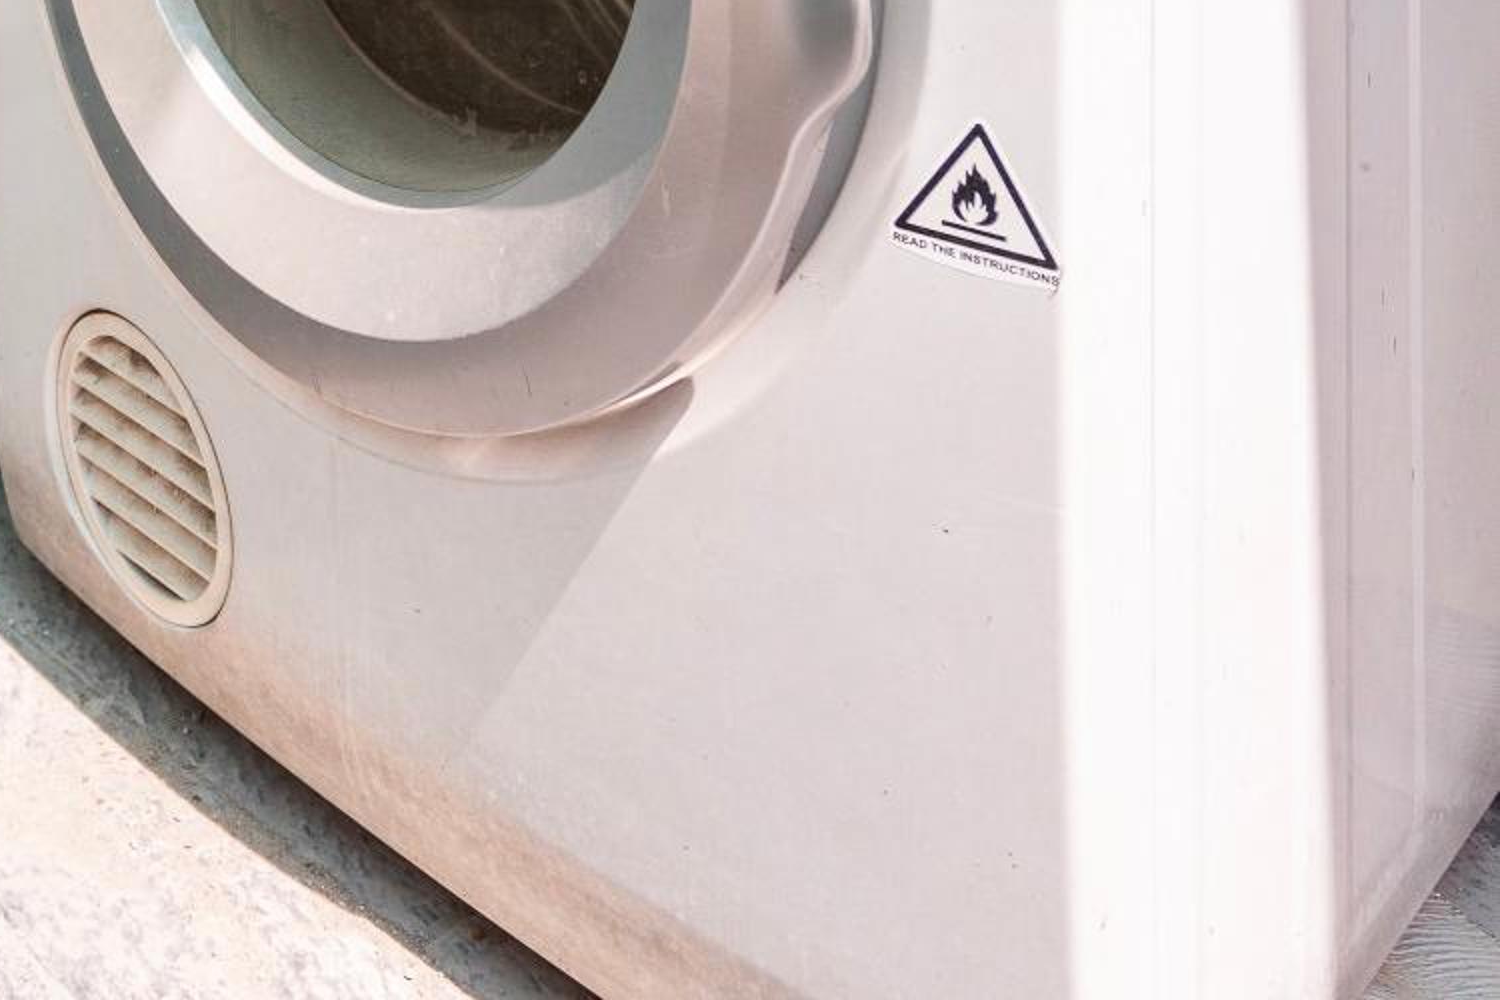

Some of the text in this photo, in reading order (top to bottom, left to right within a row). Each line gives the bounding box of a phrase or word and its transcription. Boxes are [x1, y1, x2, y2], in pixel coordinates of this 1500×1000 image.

[892, 231, 1061, 287] READ THE INSTRUCTIONS
